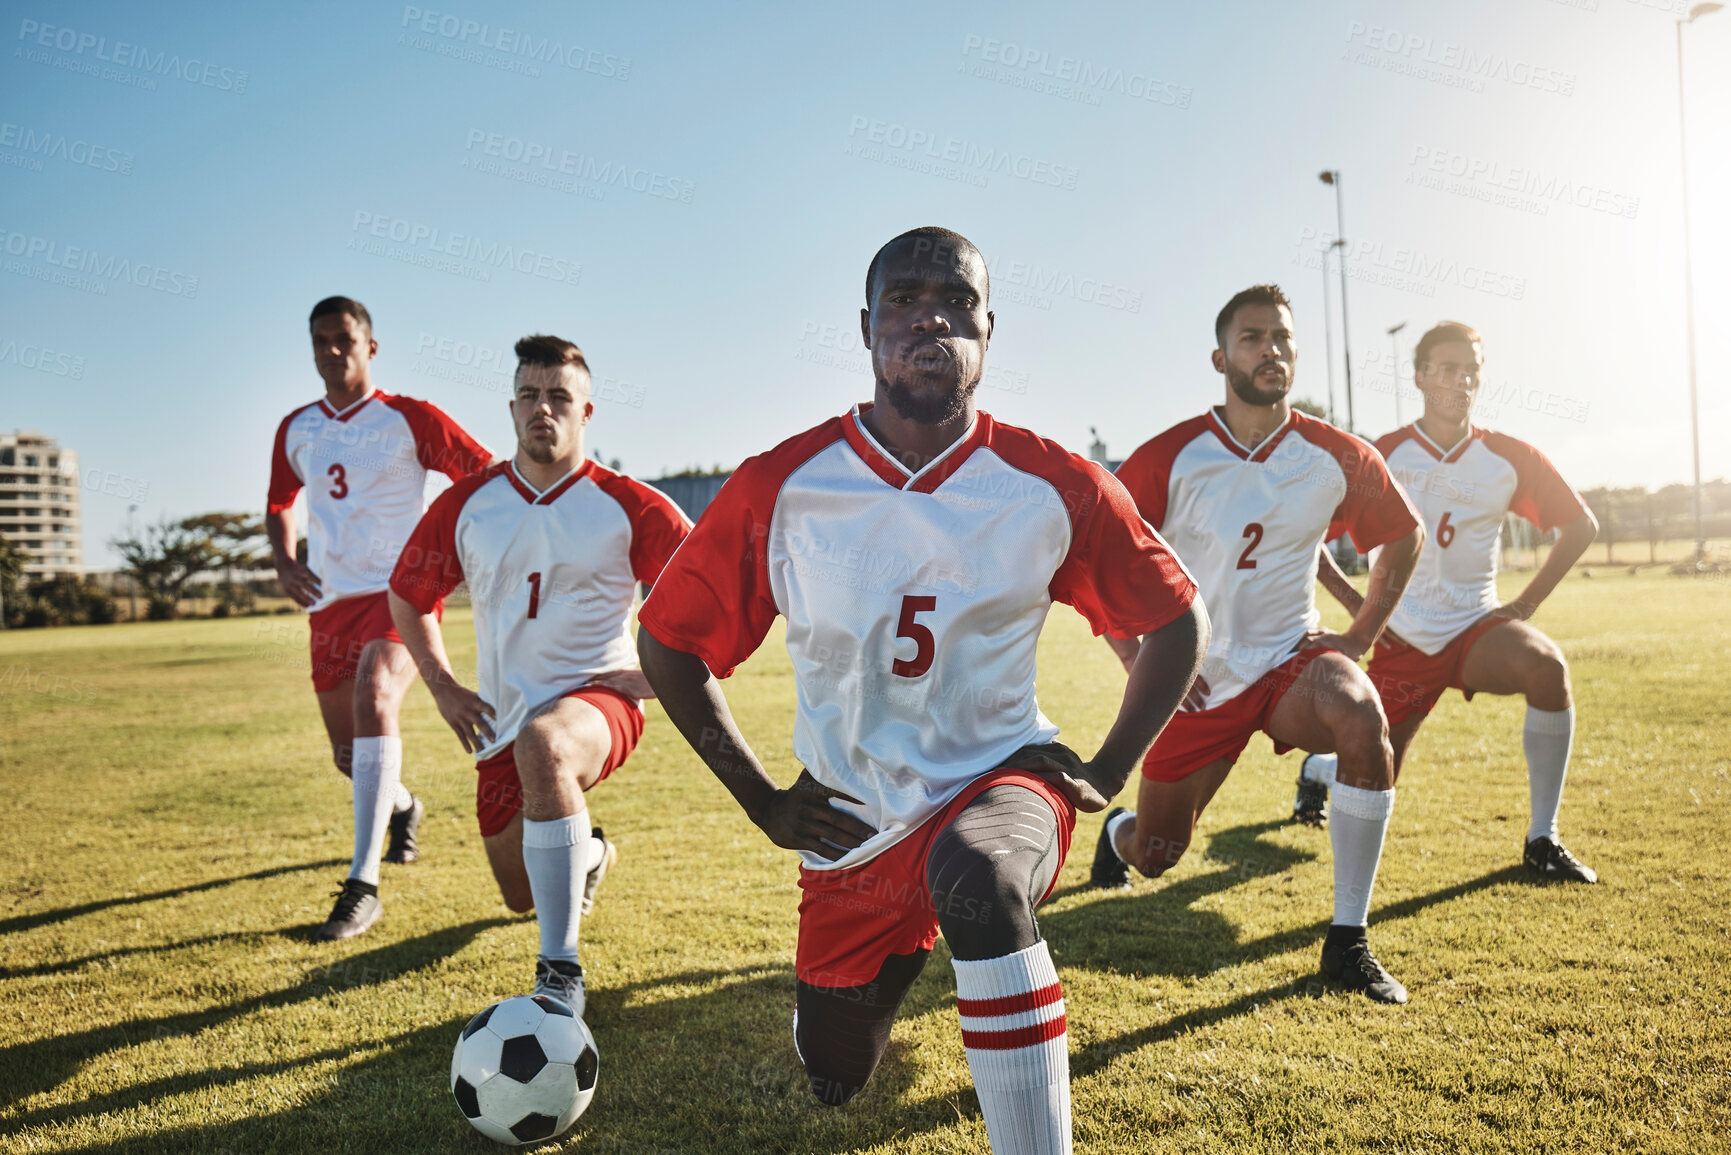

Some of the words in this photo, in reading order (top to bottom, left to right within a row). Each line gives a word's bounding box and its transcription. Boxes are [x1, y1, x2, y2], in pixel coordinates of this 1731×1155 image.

[328, 463, 349, 500] 3
[1236, 522, 1264, 571] 2
[1436, 511, 1456, 550] 6
[526, 571, 542, 620] 1
[892, 595, 937, 679] 5
